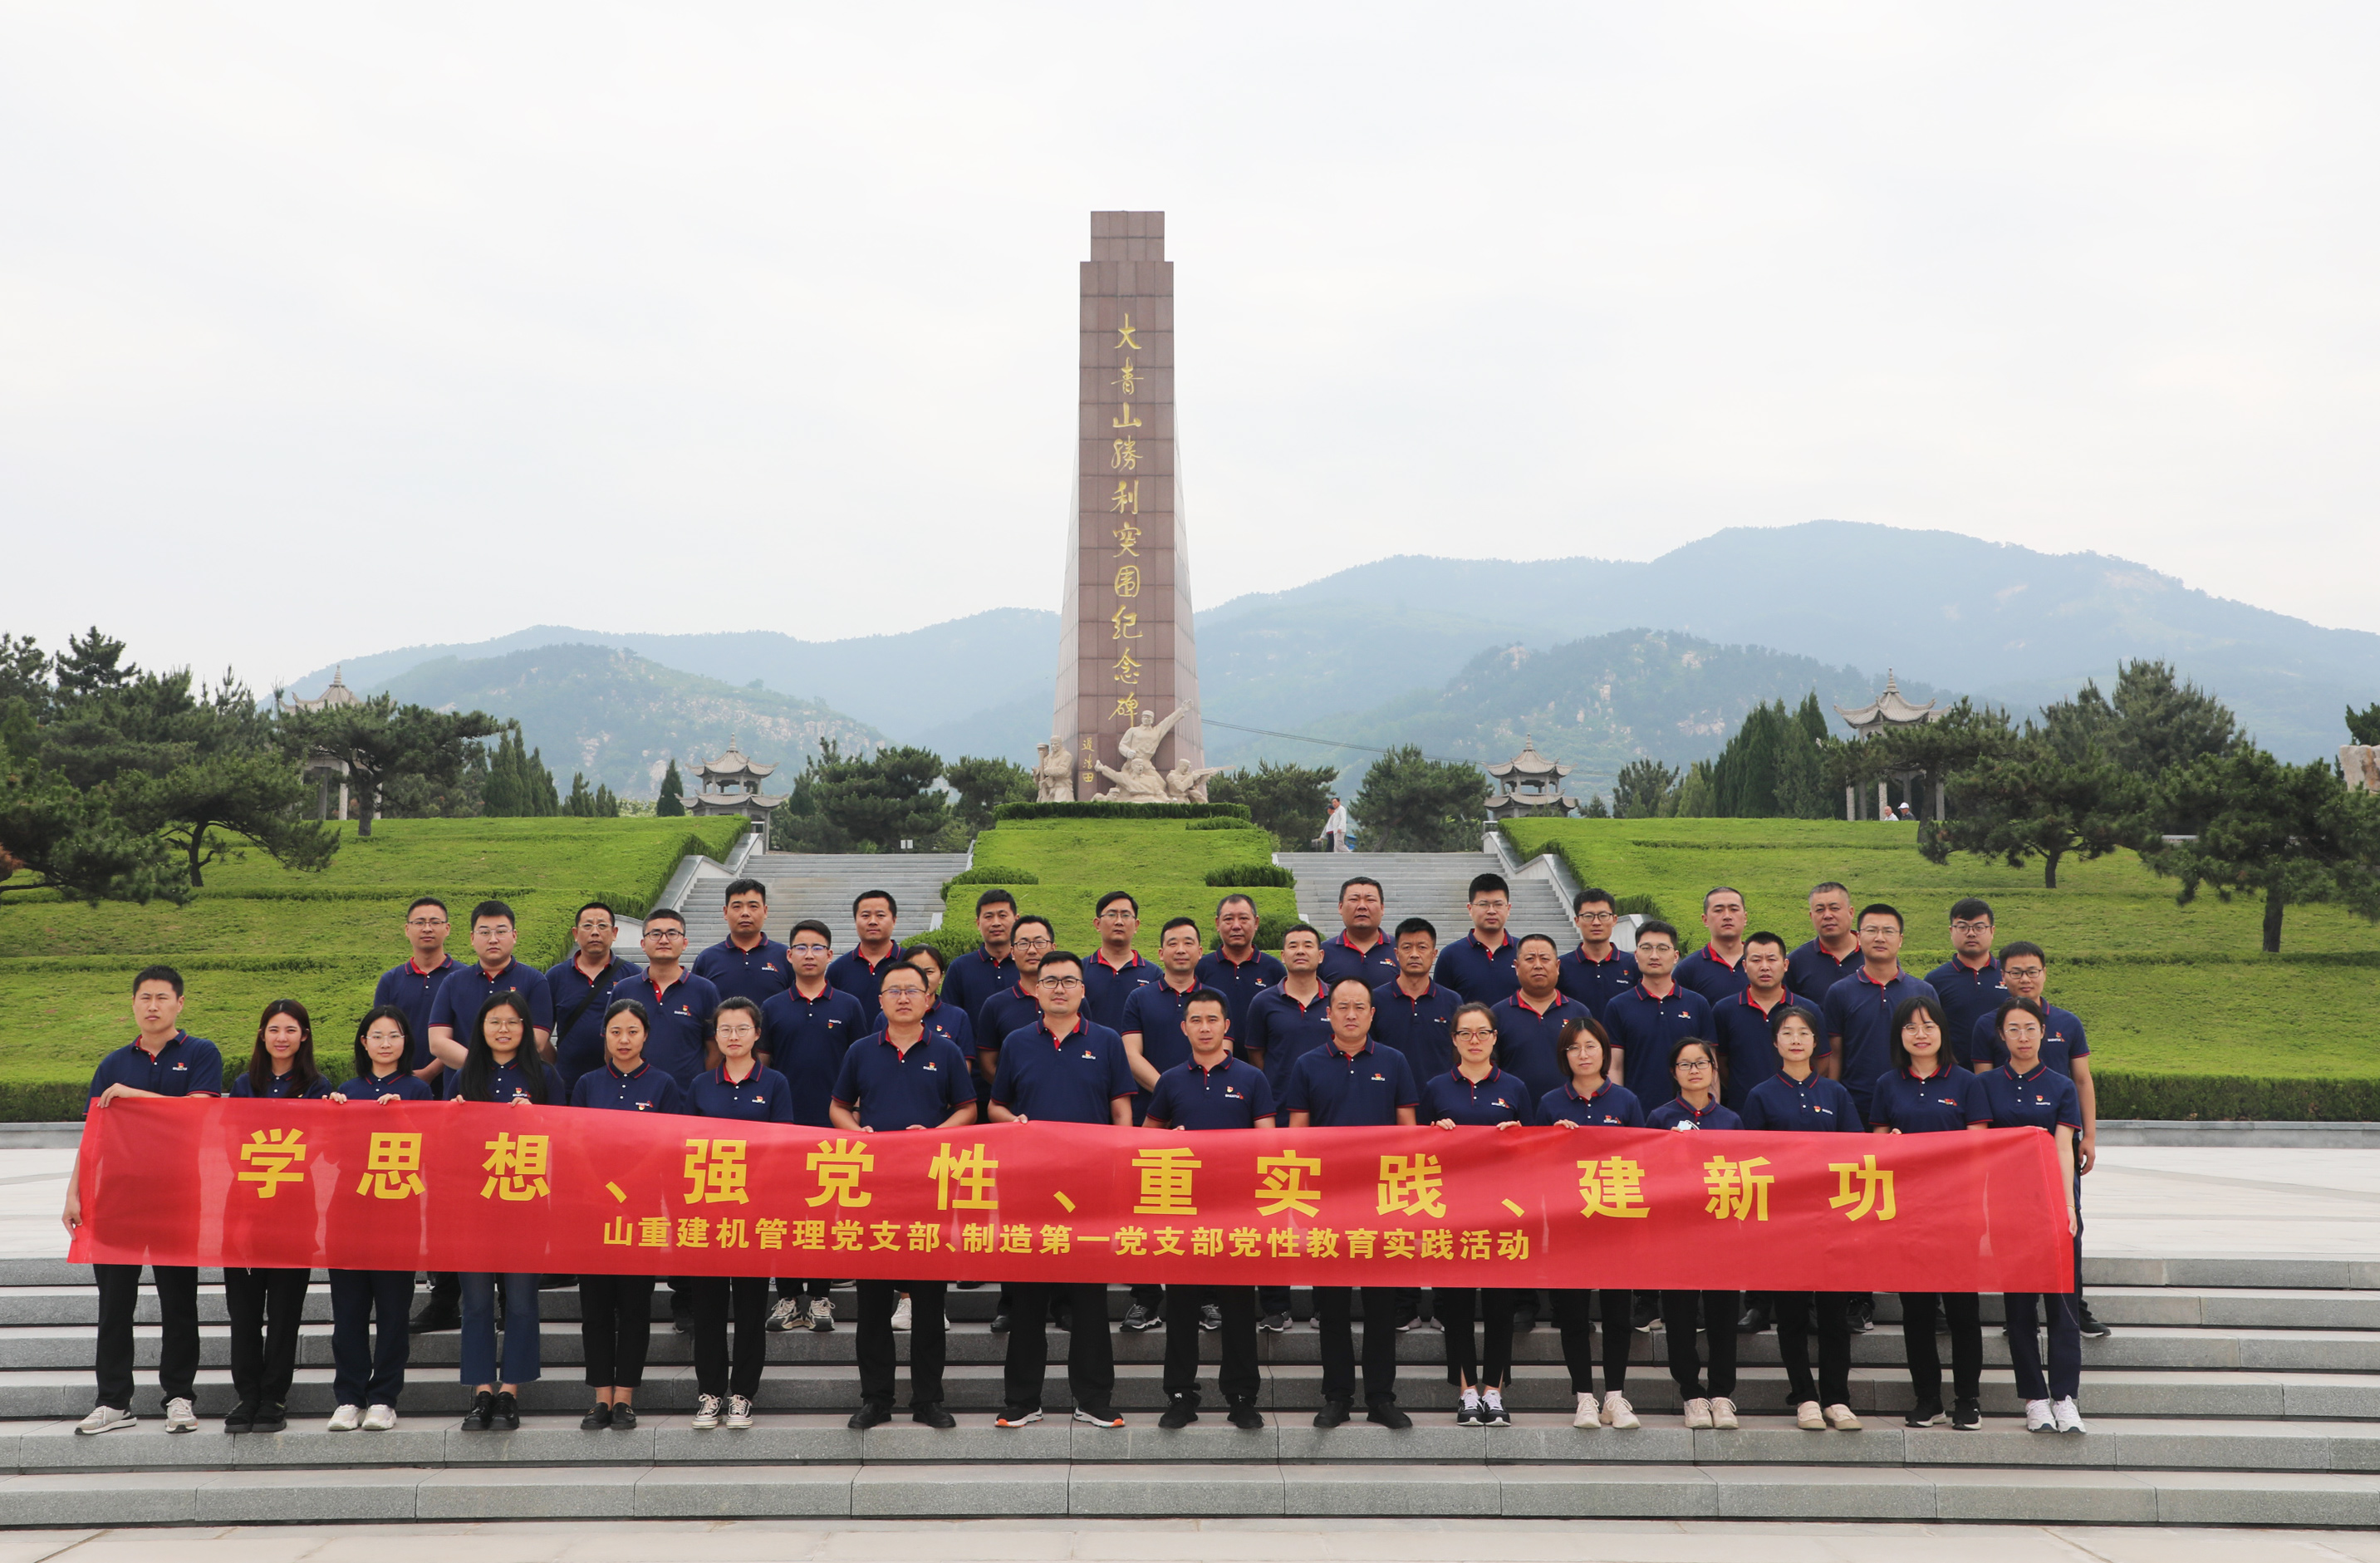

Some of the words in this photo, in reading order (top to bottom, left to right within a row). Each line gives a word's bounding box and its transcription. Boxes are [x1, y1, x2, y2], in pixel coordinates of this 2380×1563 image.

[238, 1129, 1897, 1221] 学思想、强党性、重实践、建新功
[603, 1216, 1529, 1261] 山重建机管理党支部、制造第一党支部党性教育实践活动
